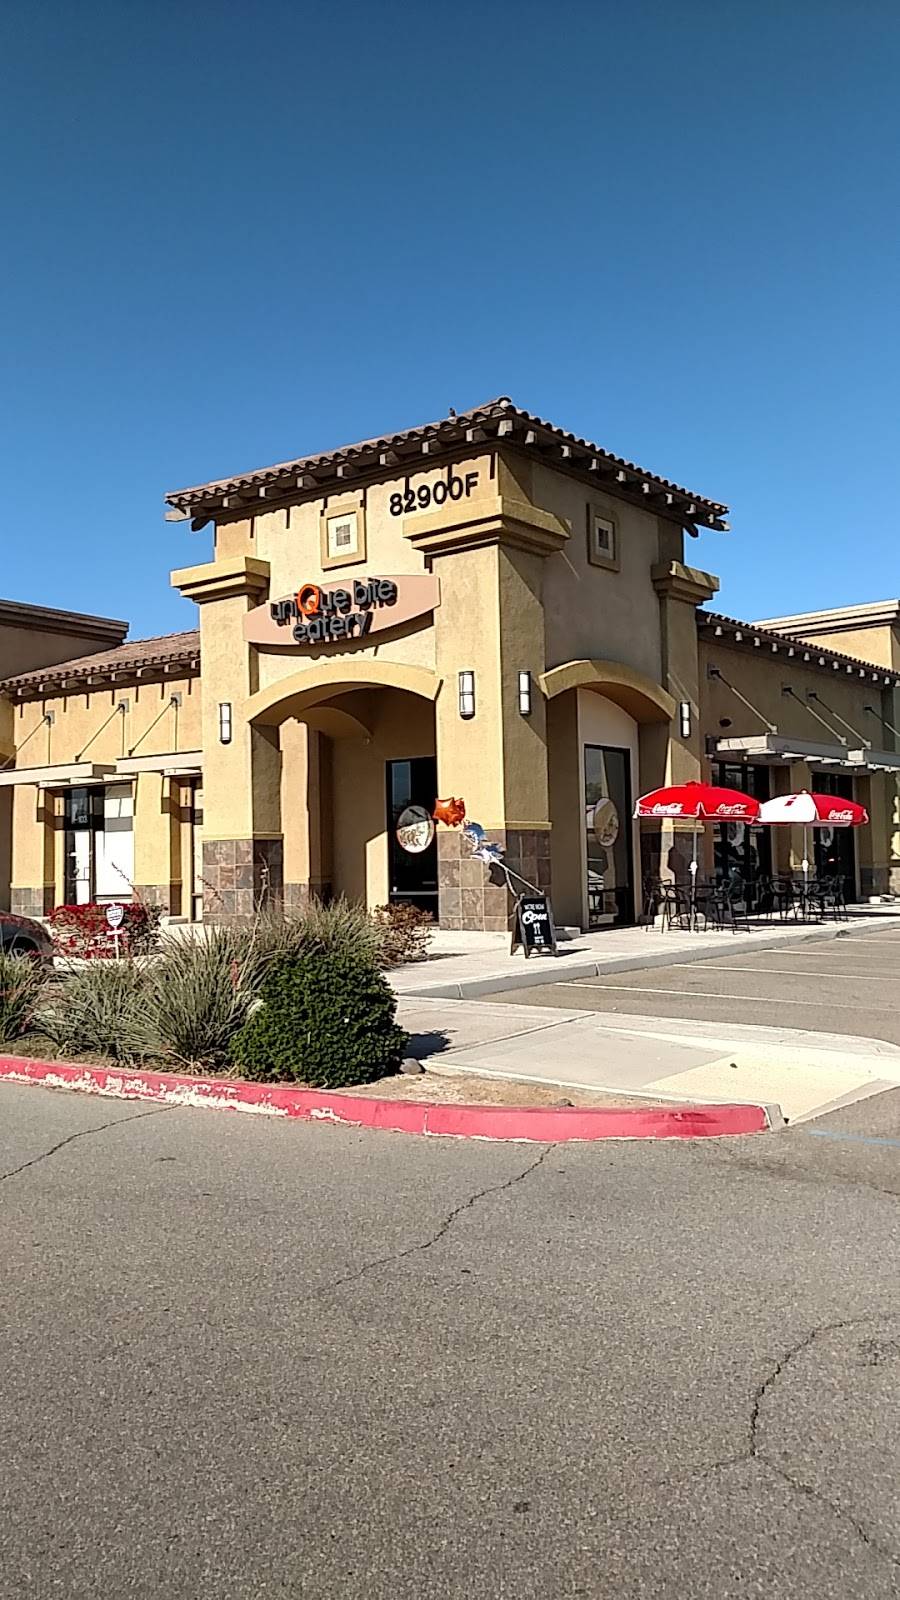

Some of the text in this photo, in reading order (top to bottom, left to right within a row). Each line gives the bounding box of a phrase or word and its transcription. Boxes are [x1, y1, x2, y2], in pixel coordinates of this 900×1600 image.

[389, 471, 479, 516] 82900F
[270, 578, 397, 623] uniQue bite
[293, 611, 373, 641] eatery
